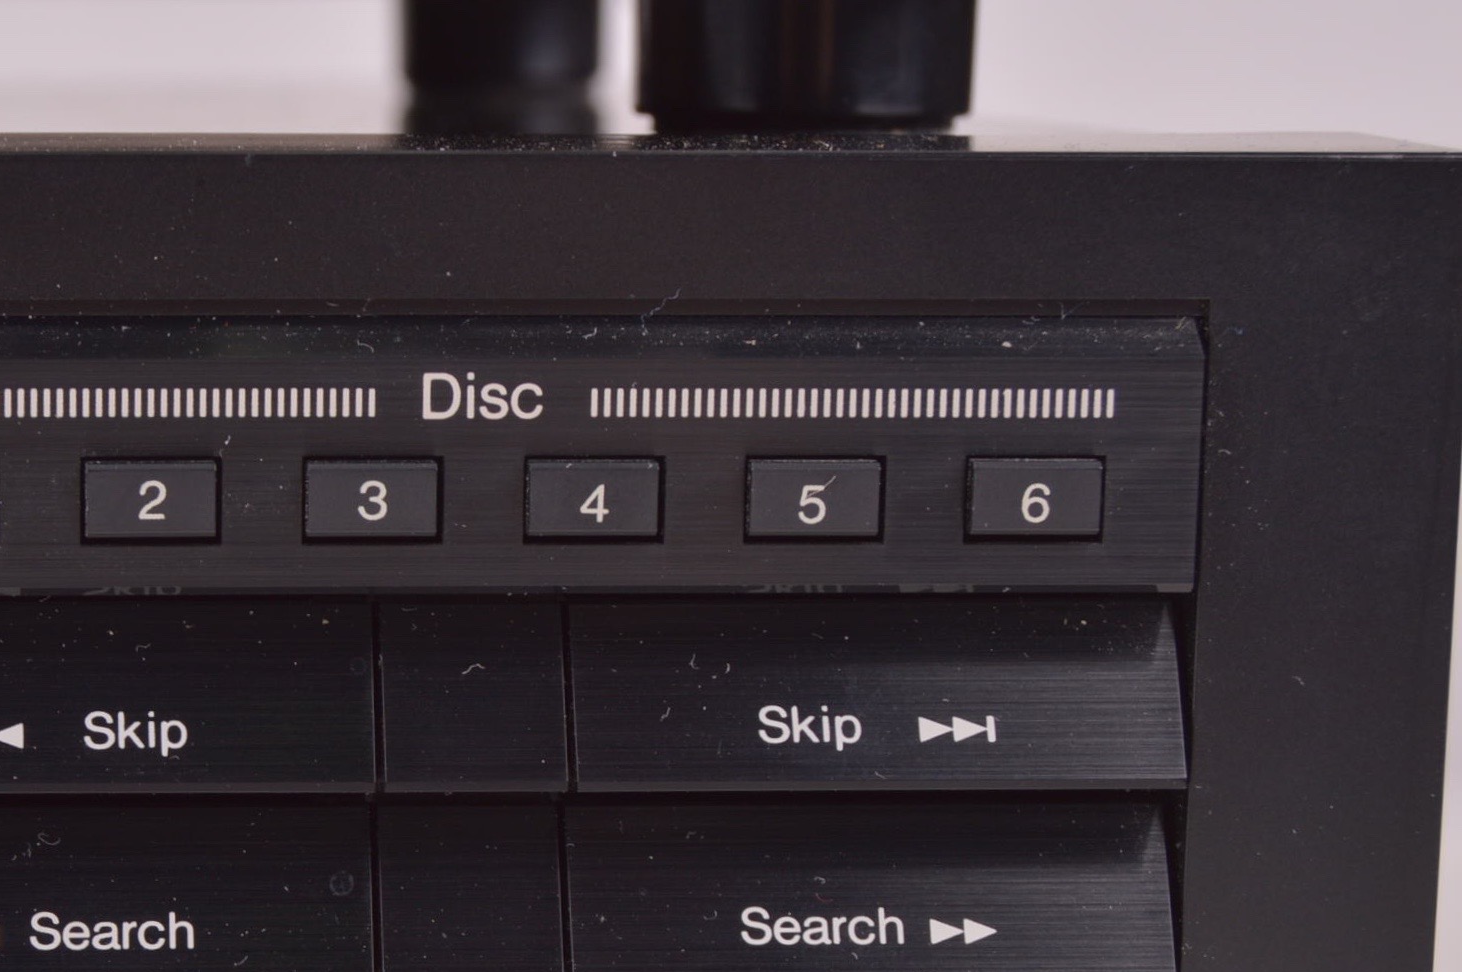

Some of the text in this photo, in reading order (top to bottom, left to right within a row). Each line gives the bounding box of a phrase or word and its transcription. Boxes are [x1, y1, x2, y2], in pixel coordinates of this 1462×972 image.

[422, 371, 544, 420] Disc
[137, 479, 167, 521] 2
[357, 479, 389, 521] 3
[579, 483, 610, 523] 4
[797, 484, 828, 525] 5
[1020, 482, 1051, 524] 6
[83, 710, 188, 757] Skip
[758, 704, 863, 751] Skip
[29, 911, 195, 951] Search
[740, 906, 905, 946] Search
